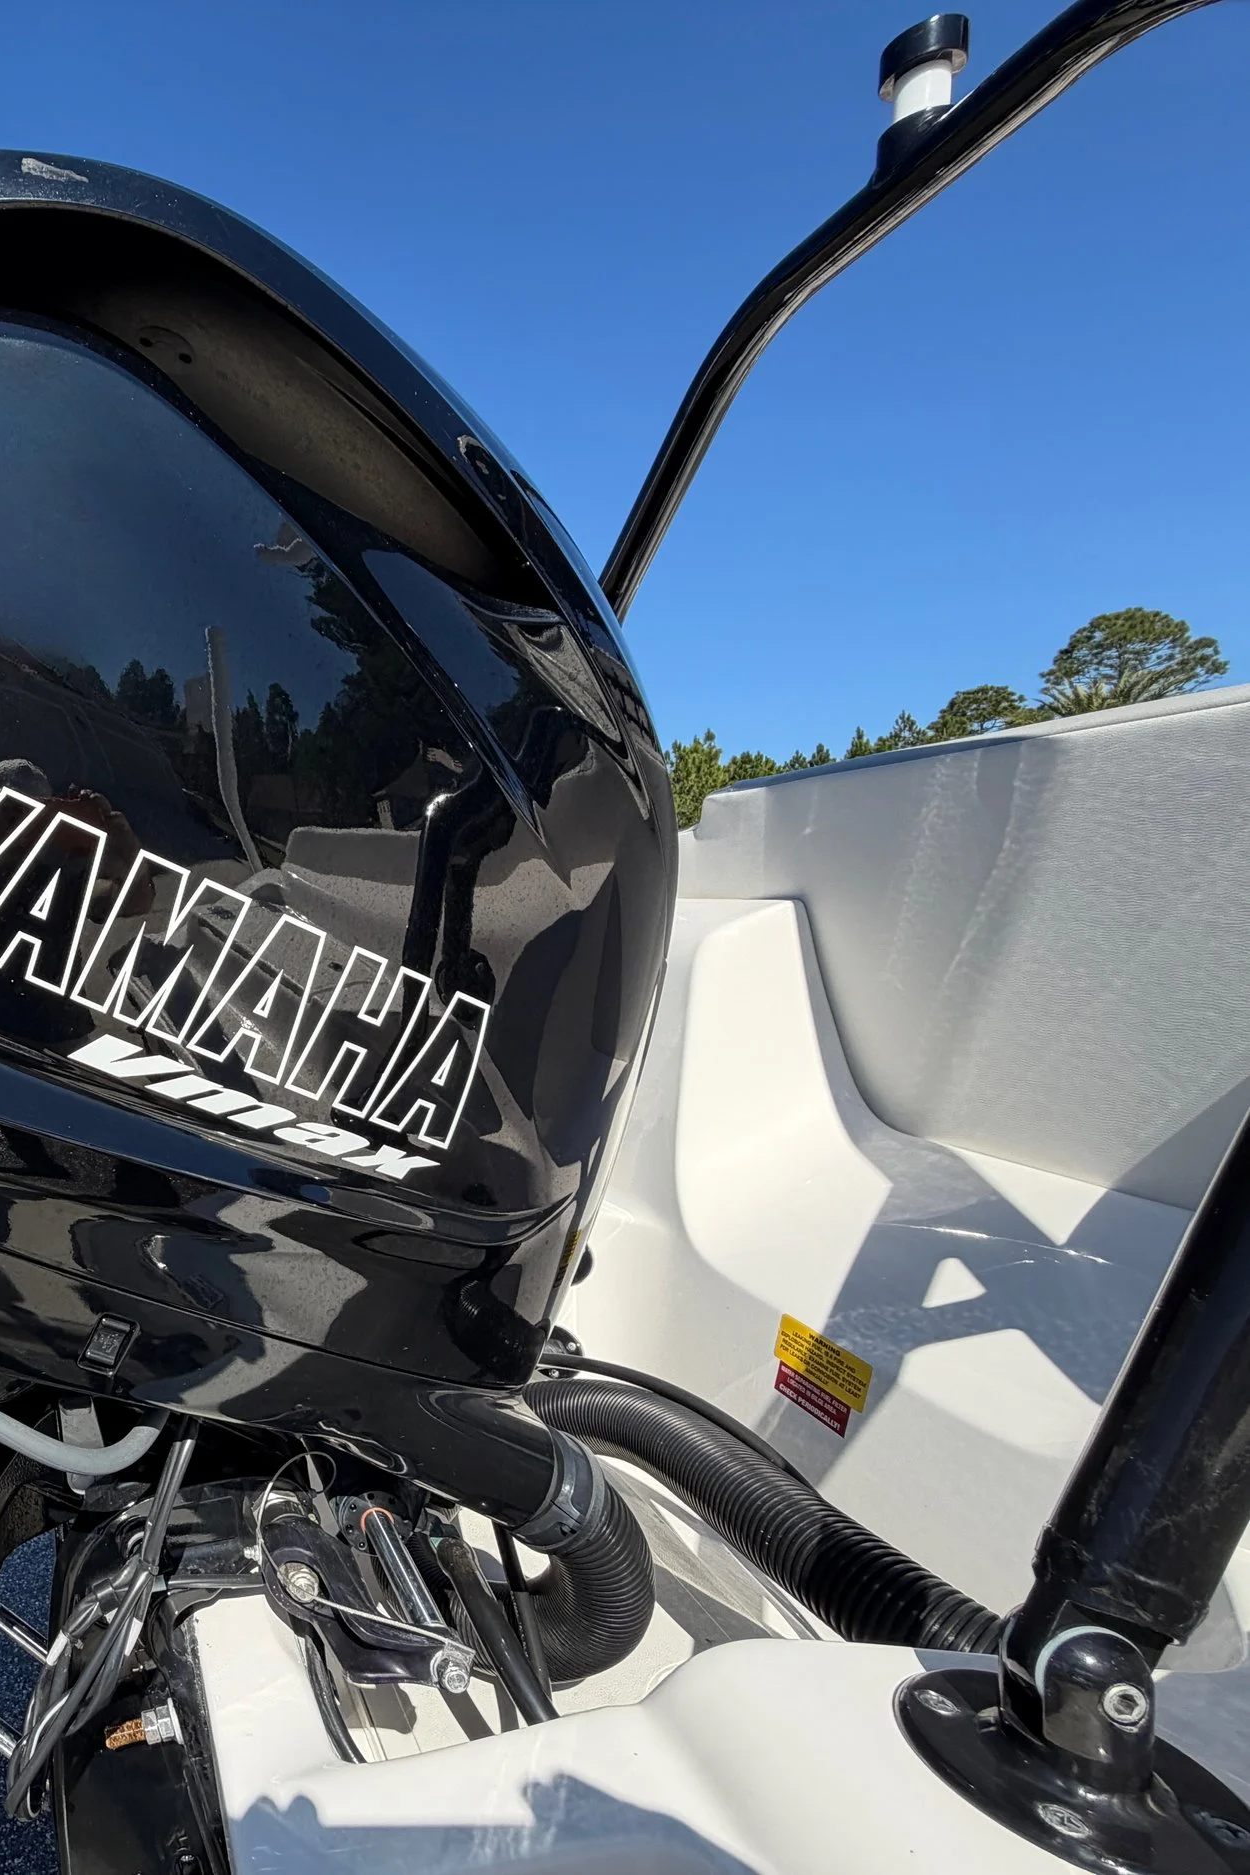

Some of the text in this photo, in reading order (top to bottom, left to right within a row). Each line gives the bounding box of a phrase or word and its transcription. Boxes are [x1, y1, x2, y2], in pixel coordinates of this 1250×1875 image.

[781, 1330, 804, 1348] EXPLOSION
[825, 1358, 845, 1375] INSPECT
[846, 1371, 866, 1388] SYSTEM
[792, 1330, 811, 1345] LEAKING
[811, 1342, 823, 1353] FUEL
[833, 1356, 844, 1366] FIRE
[844, 1363, 855, 1374] AND
[808, 1332, 840, 1357] WARNING
[780, 1343, 789, 1352] FOR
[844, 1385, 861, 1400] LEAST
[808, 1355, 828, 1371] EXAMINE
[829, 1368, 840, 1379] FUEL
[841, 1376, 861, 1392] SYSTEM
[779, 1382, 840, 1431] CHECK PERIODICALLY!
[820, 1391, 831, 1403] FUEL
[831, 1399, 847, 1413] FILTER
